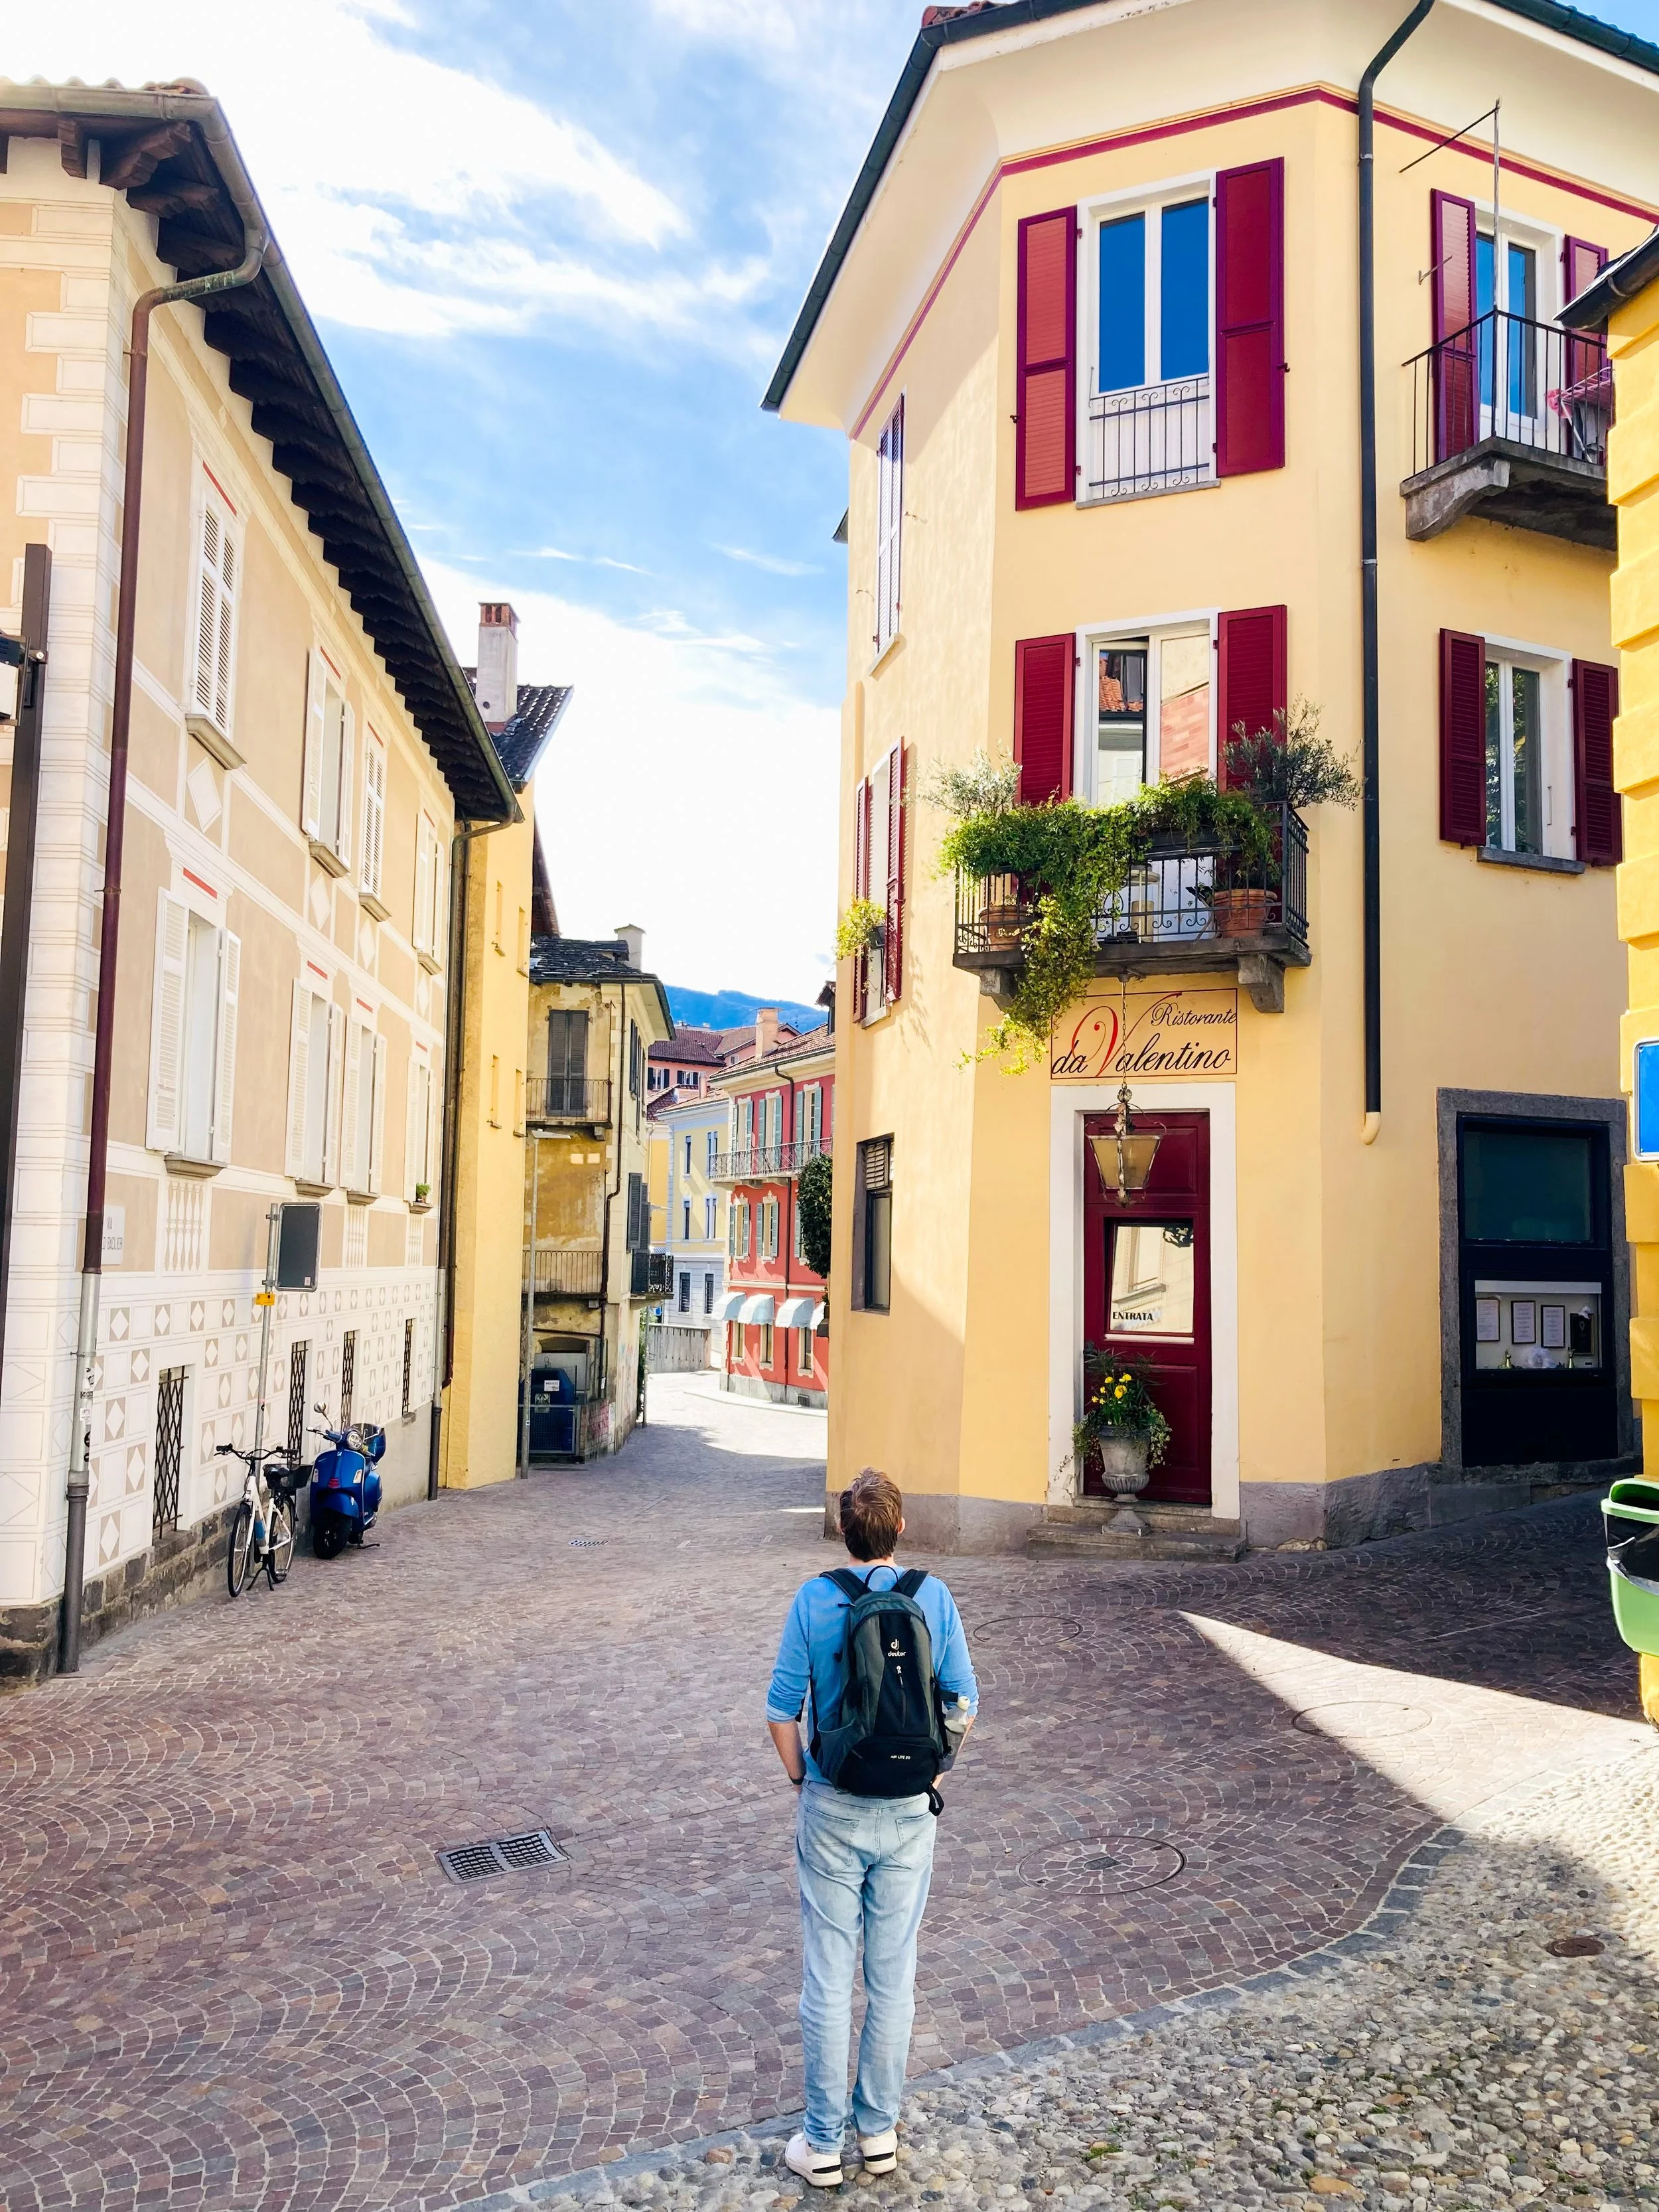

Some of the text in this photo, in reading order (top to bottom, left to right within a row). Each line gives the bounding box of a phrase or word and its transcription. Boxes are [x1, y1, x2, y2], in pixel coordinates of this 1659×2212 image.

[1151, 1002, 1236, 1026] Ristorante
[1052, 992, 1231, 1078] da Valentino
[1112, 1311, 1154, 1321] ENTRATA
